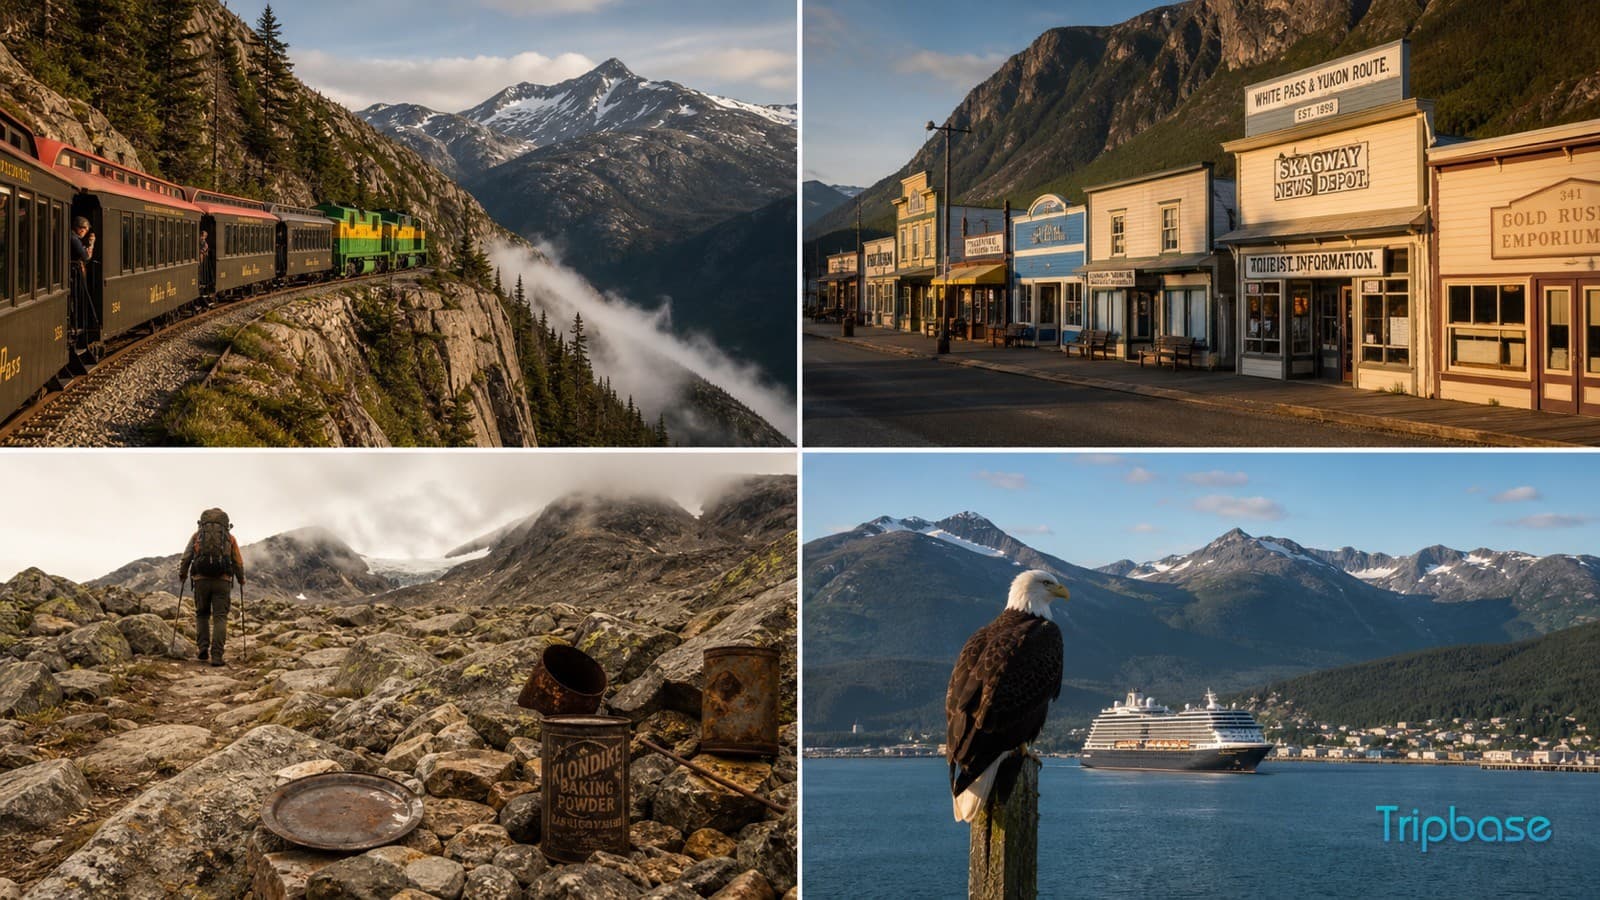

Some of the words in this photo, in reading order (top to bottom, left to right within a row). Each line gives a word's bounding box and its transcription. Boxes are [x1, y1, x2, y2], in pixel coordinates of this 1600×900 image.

[1254, 87, 1281, 107] WHITE
[1283, 80, 1306, 100] PASS
[1308, 78, 1316, 93] &
[1317, 67, 1349, 90] YUKON
[1352, 56, 1390, 81] ROUTE.
[1298, 107, 1314, 120] EST.
[1279, 145, 1362, 179] SKAGWAY
[1274, 178, 1313, 199] NEWS
[1560, 188, 1582, 201] 341
[1502, 210, 1547, 228] GOLD
[1558, 205, 1600, 223] RUS
[1502, 228, 1600, 249] EMPORIUM
[0, 345, 21, 383] Pass
[560, 778, 614, 796] BAKING
[557, 794, 615, 812] POWDER
